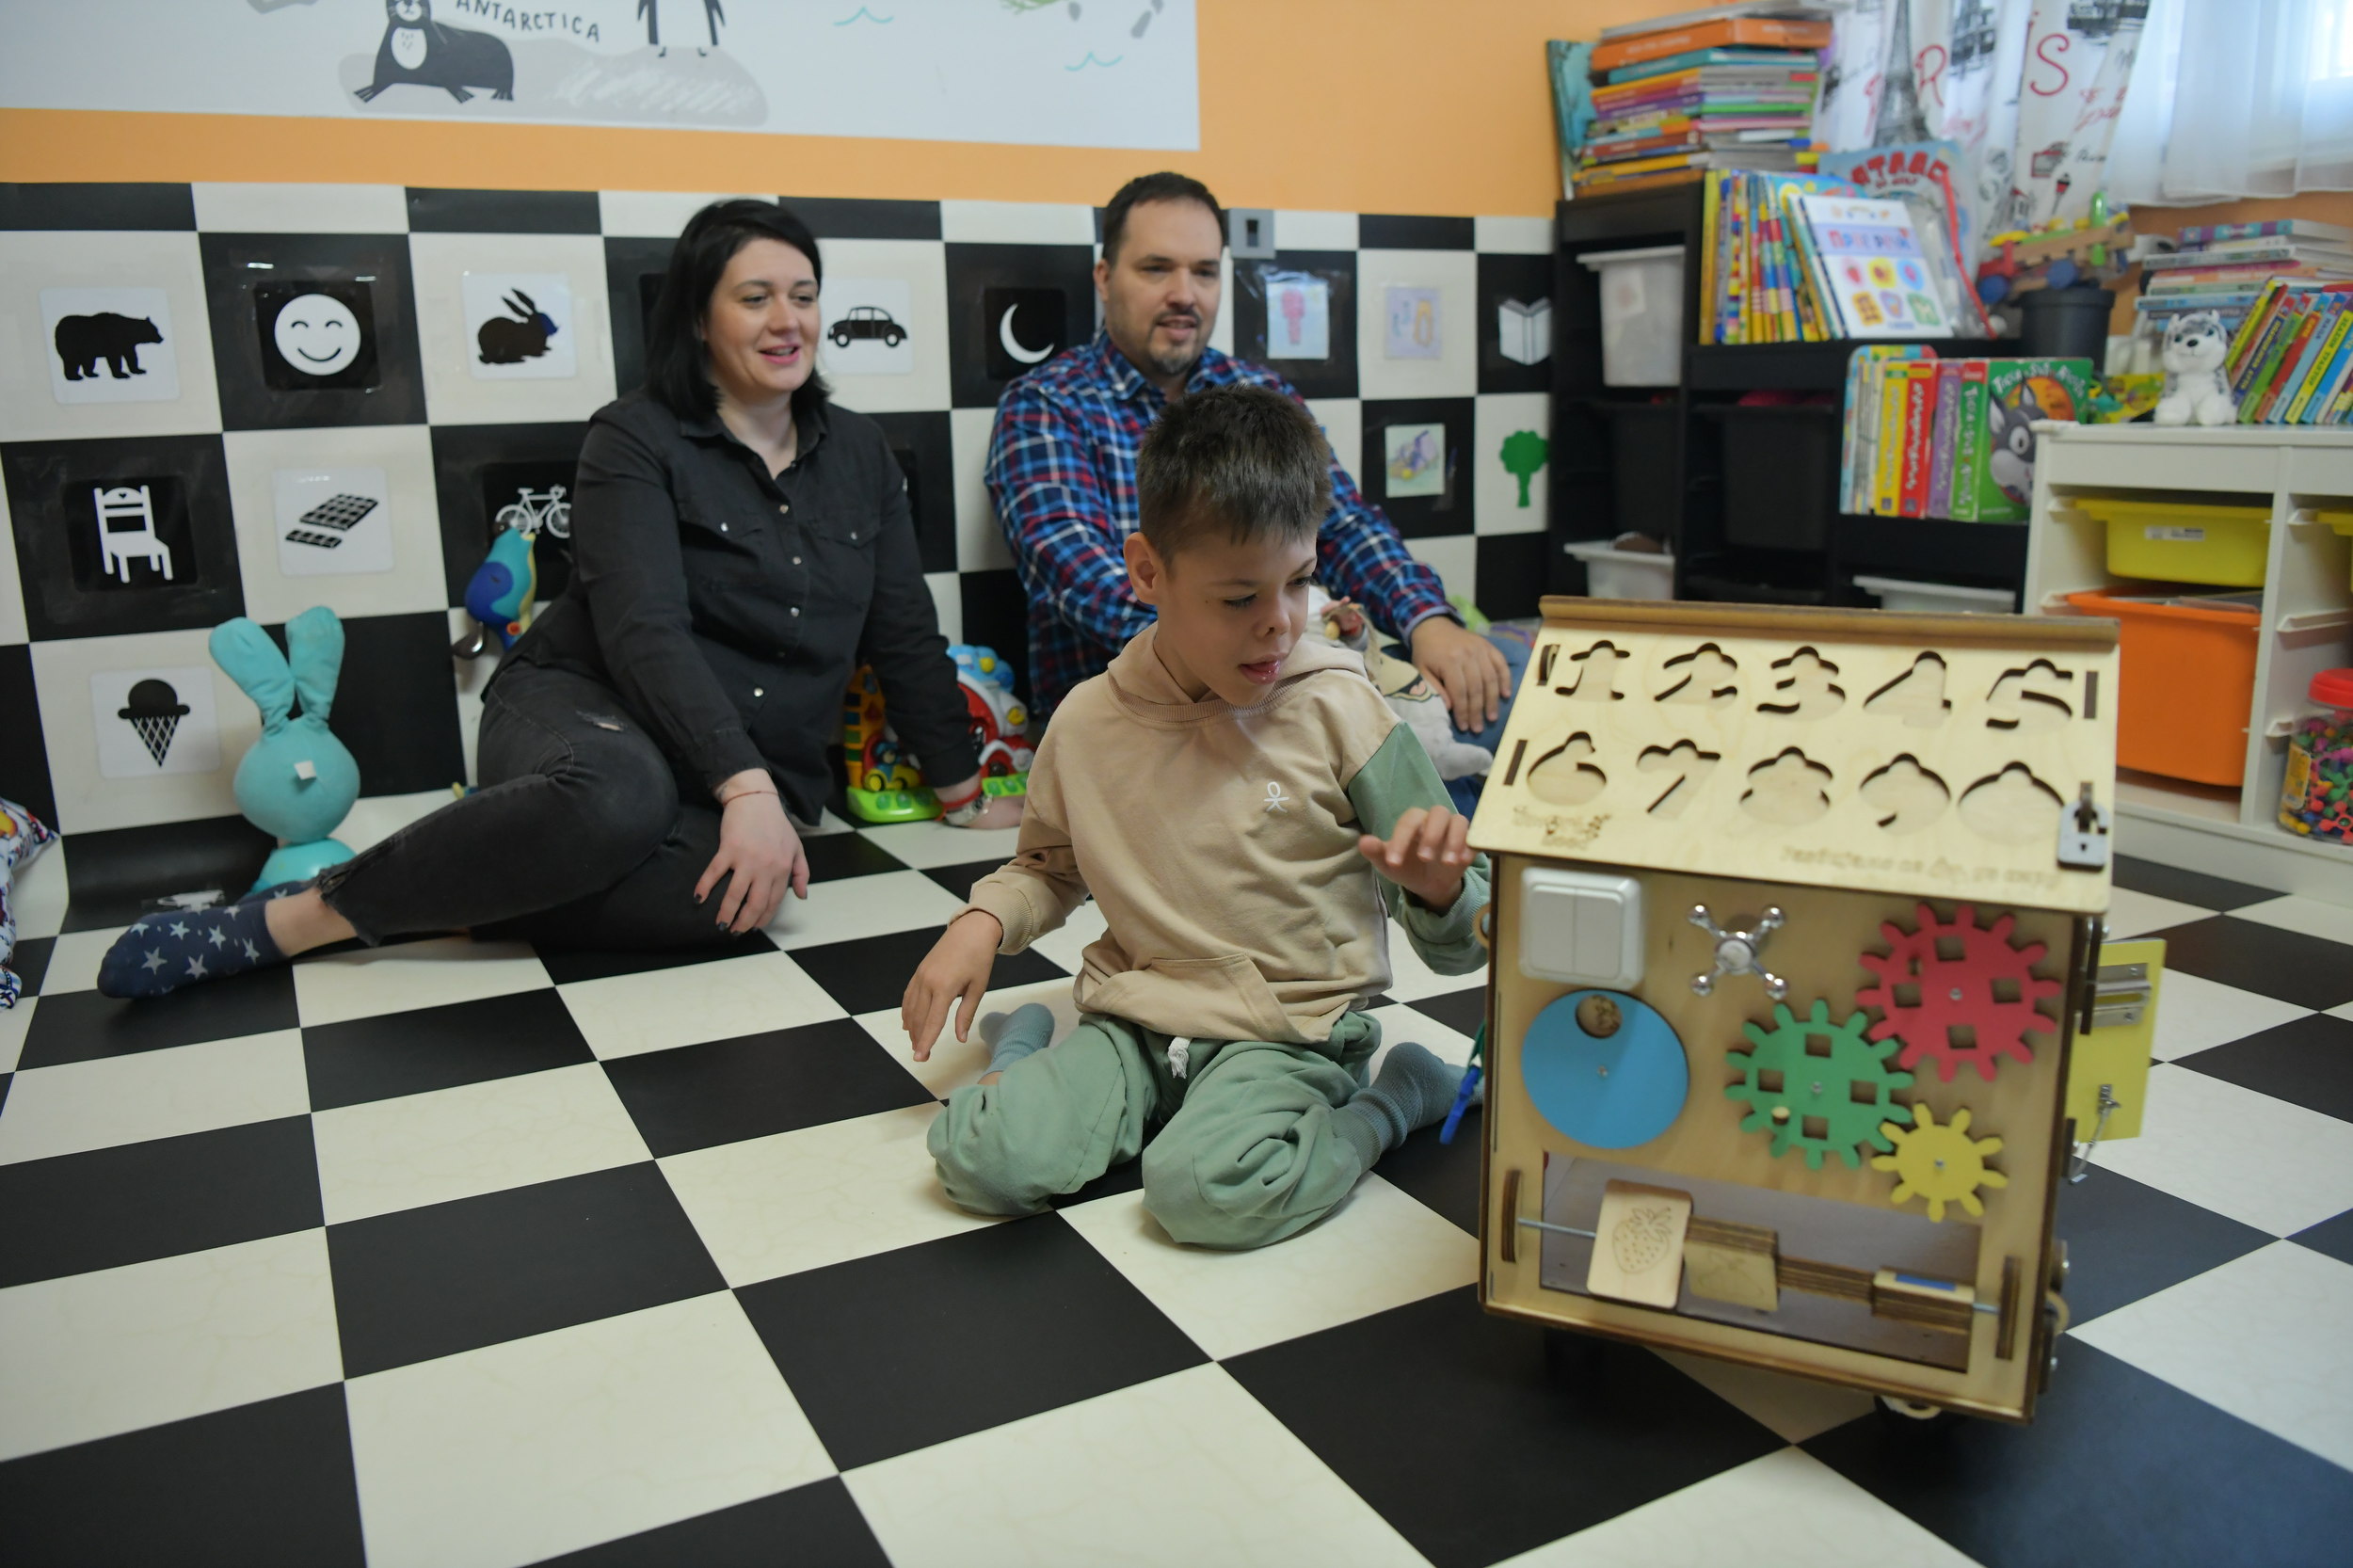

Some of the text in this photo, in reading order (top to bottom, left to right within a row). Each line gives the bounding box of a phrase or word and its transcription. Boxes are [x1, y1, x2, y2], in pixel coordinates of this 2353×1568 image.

[456, 0, 600, 43] ANTARCTICA
[1654, 642, 1739, 710] 2
[1756, 645, 1847, 722] 3
[1863, 649, 1952, 728] 4
[1986, 658, 2073, 731] 5
[1527, 730, 1608, 807] 6
[1636, 738, 1721, 820] 7
